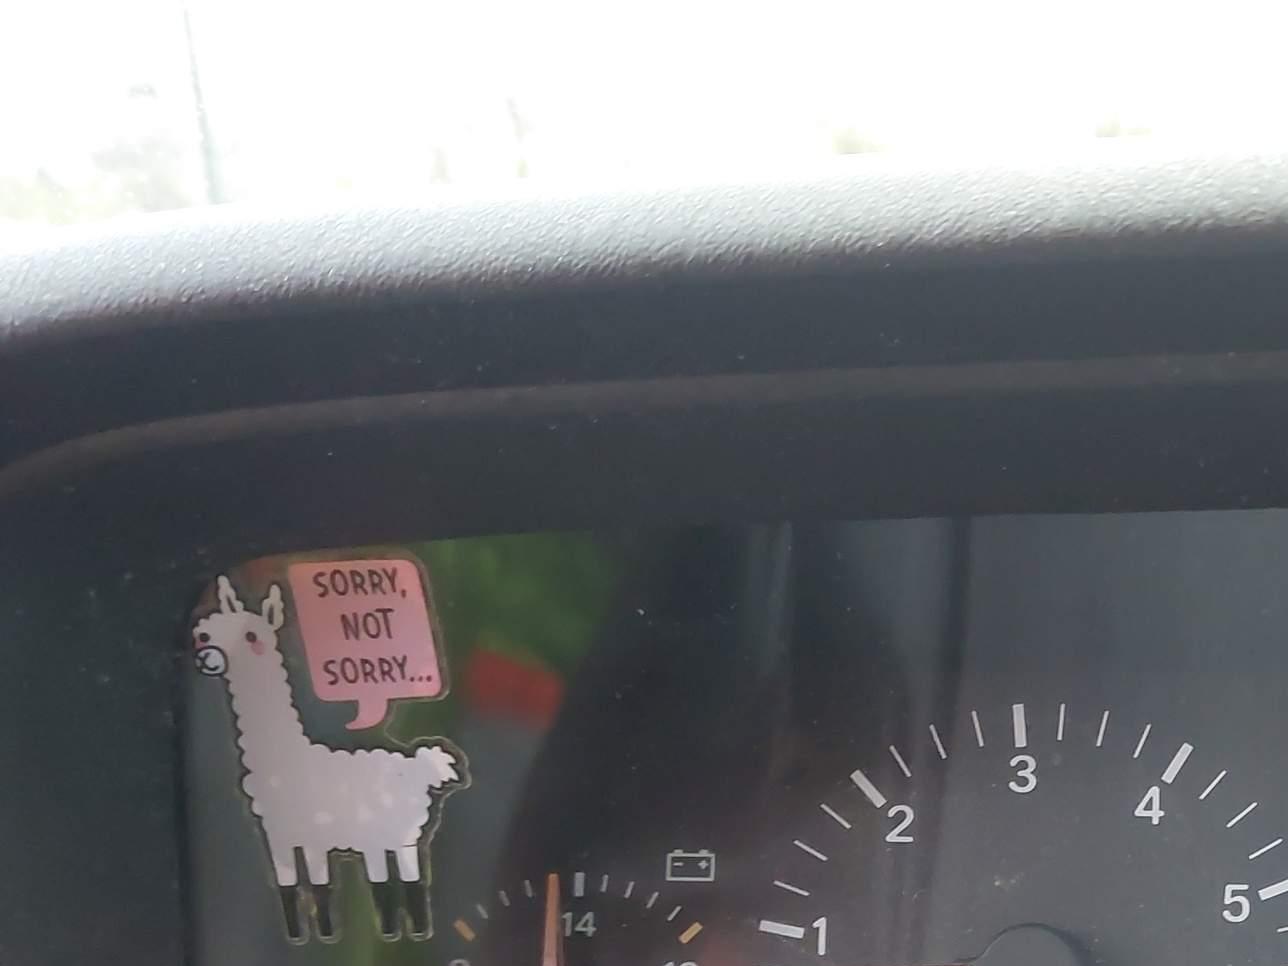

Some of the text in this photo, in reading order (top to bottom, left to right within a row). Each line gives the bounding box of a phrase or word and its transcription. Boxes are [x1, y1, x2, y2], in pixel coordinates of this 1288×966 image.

[313, 568, 407, 599] SORRY,
[340, 608, 395, 641] NOT
[322, 655, 433, 686] SORRY...
[1008, 755, 1037, 793] 3
[886, 804, 914, 843] 2
[1134, 786, 1165, 824] 4
[1223, 884, 1250, 923] 5
[561, 911, 596, 937] 14
[811, 917, 828, 955] 1
